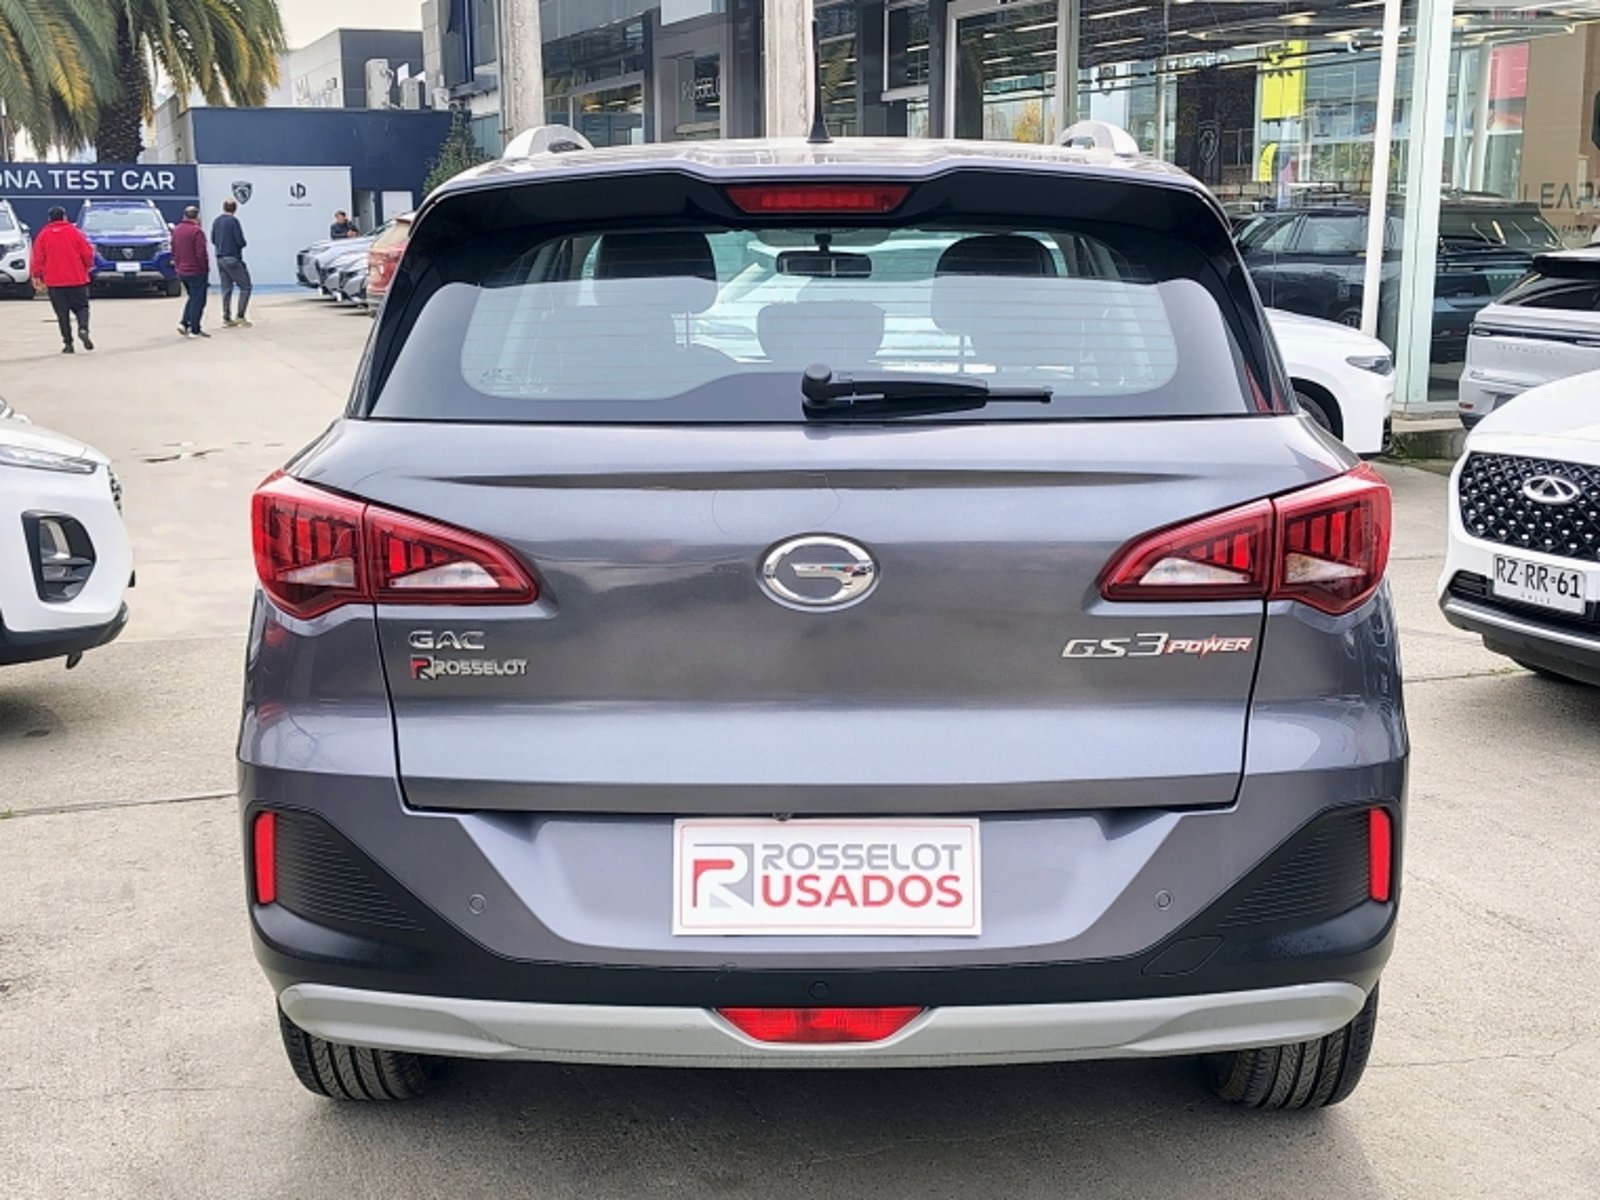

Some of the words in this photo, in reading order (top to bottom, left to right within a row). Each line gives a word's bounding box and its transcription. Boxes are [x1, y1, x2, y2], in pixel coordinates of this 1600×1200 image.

[0, 170, 43, 189] NA
[48, 170, 115, 190] TEST
[121, 171, 176, 191] CAR
[408, 630, 485, 649] GAC
[1062, 632, 1169, 658] GS3
[1165, 634, 1253, 657] POWER
[434, 659, 528, 675] ROSSELOT
[762, 843, 963, 871] ROSSELOT
[762, 875, 963, 908] USADOS
